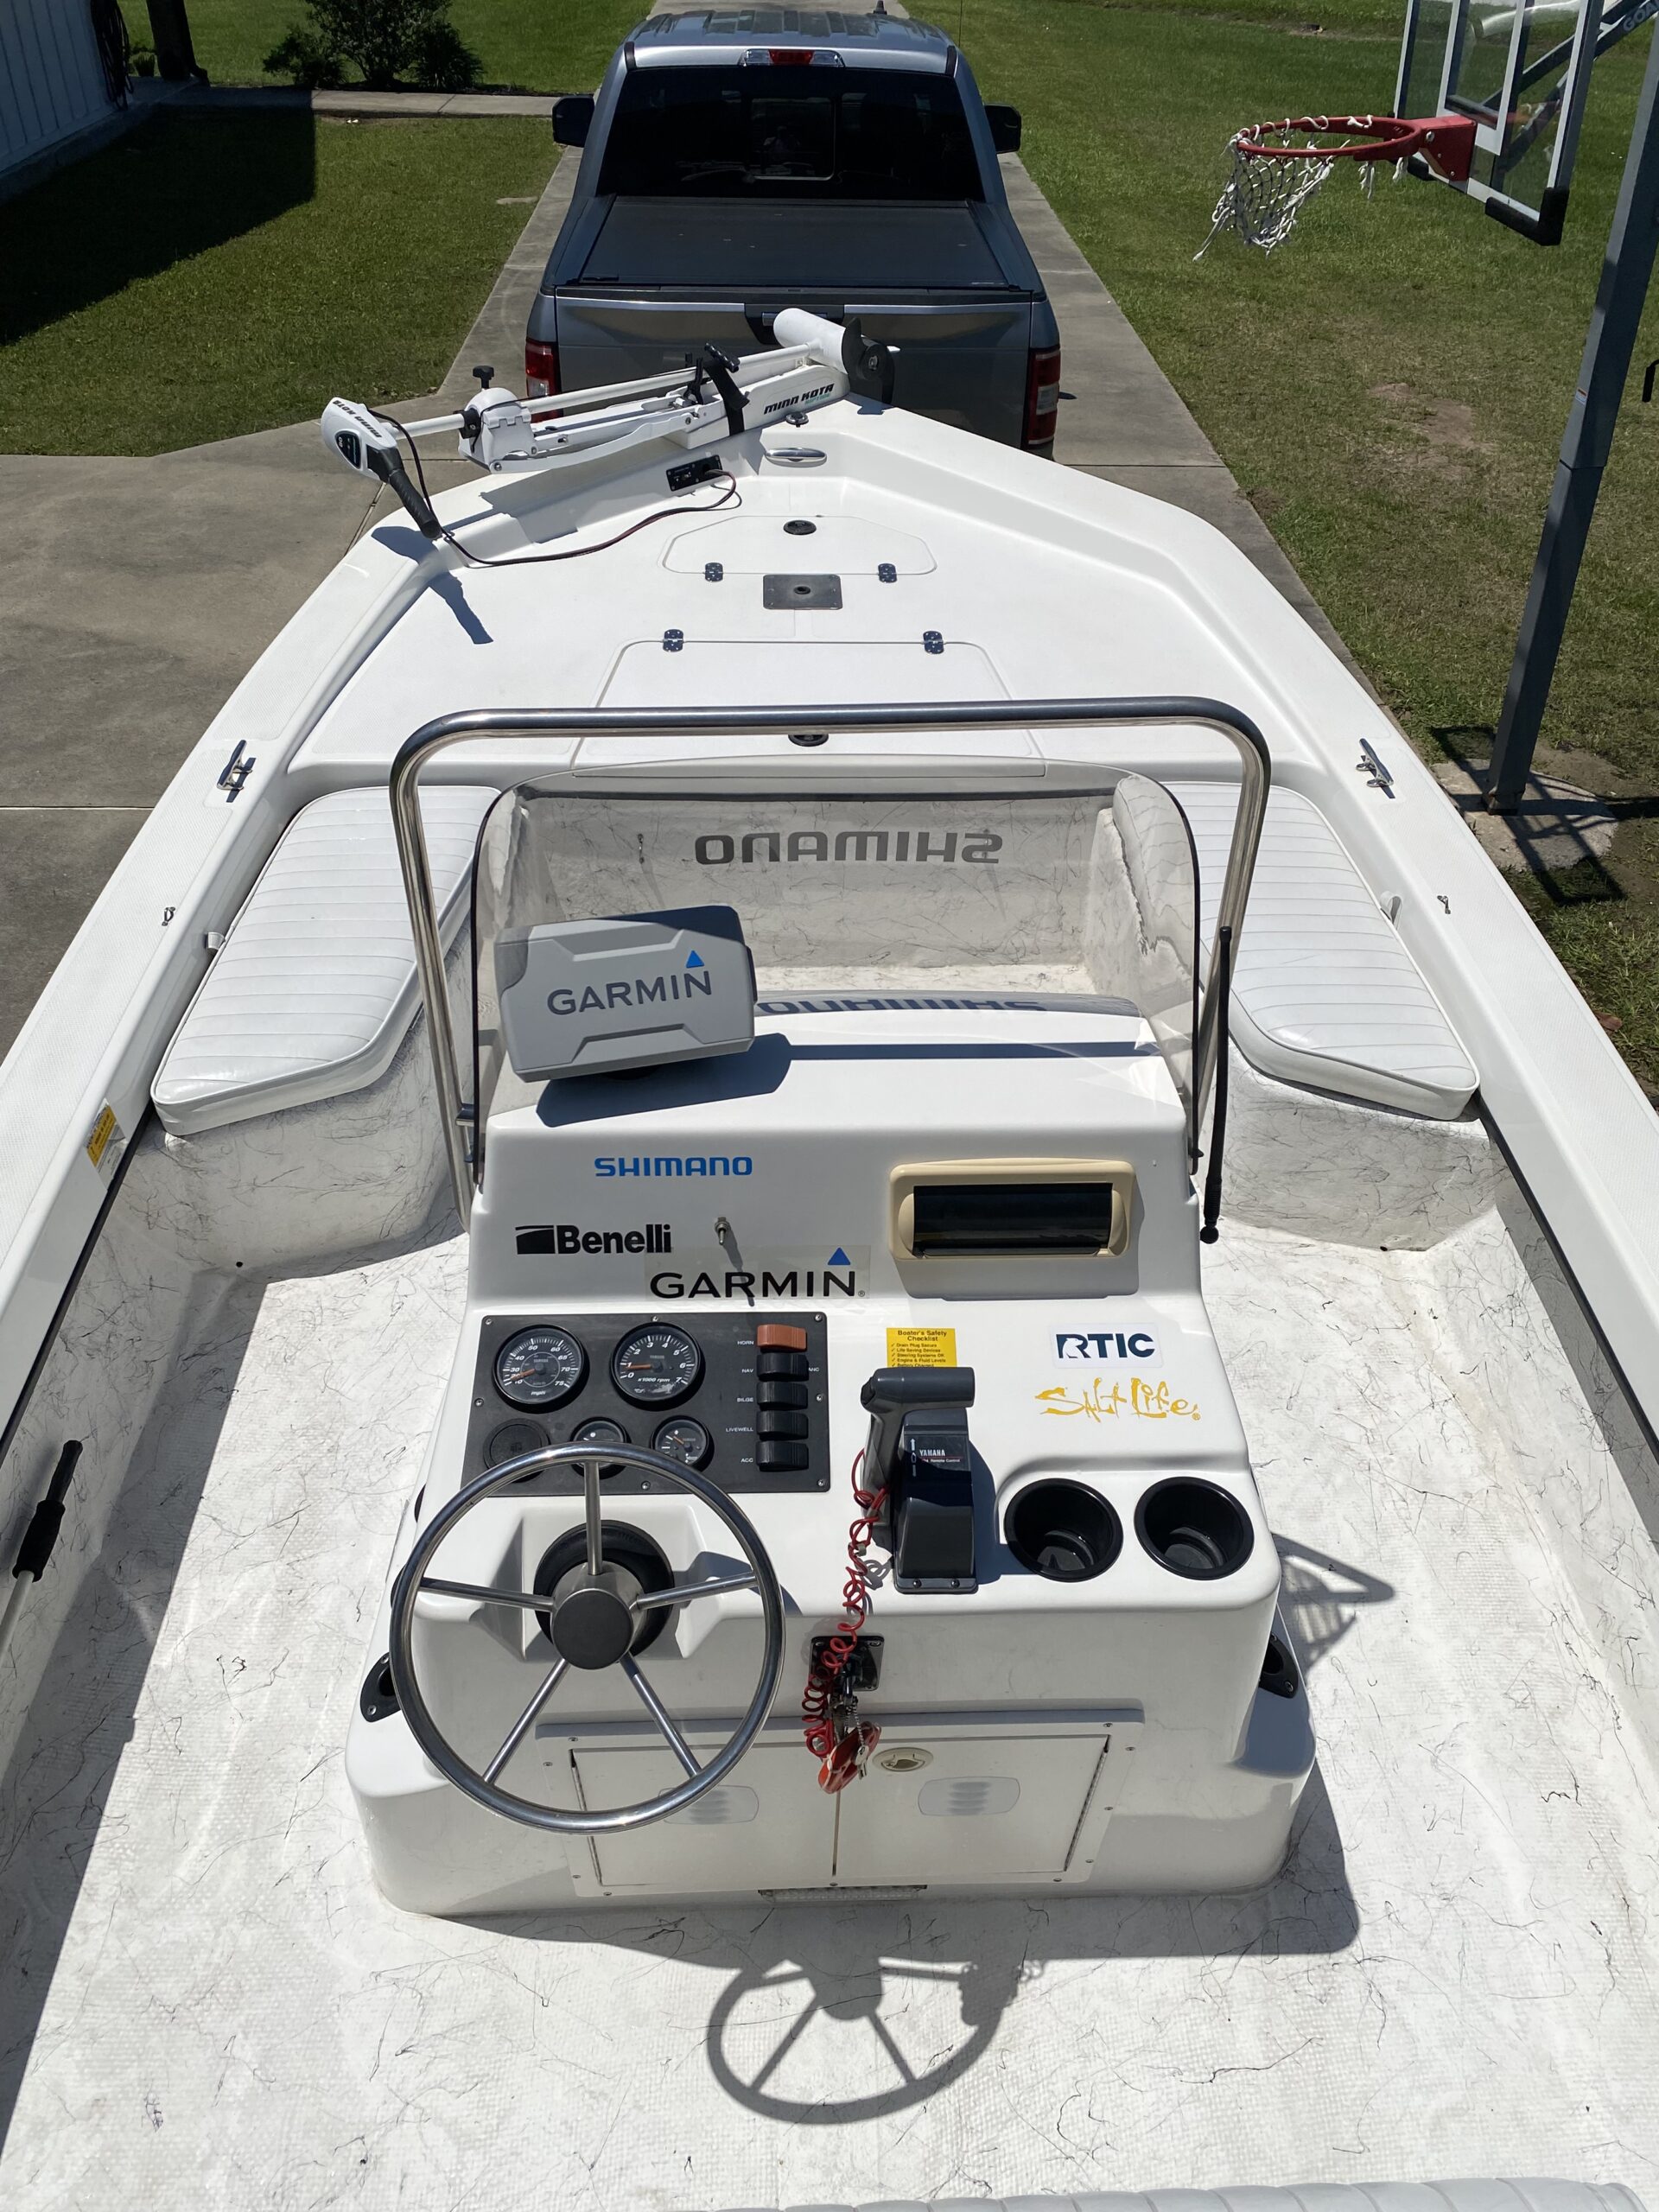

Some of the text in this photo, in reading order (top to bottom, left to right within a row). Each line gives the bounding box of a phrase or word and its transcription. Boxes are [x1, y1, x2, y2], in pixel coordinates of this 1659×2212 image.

[764, 383, 834, 414] MINN KOTA
[547, 970, 712, 1015] GARMIN
[594, 1156, 753, 1177] SHIMANO
[556, 1224, 672, 1254] Benelli
[650, 1271, 855, 1299] GARMIN
[1056, 1333, 1155, 1358] RTIC
